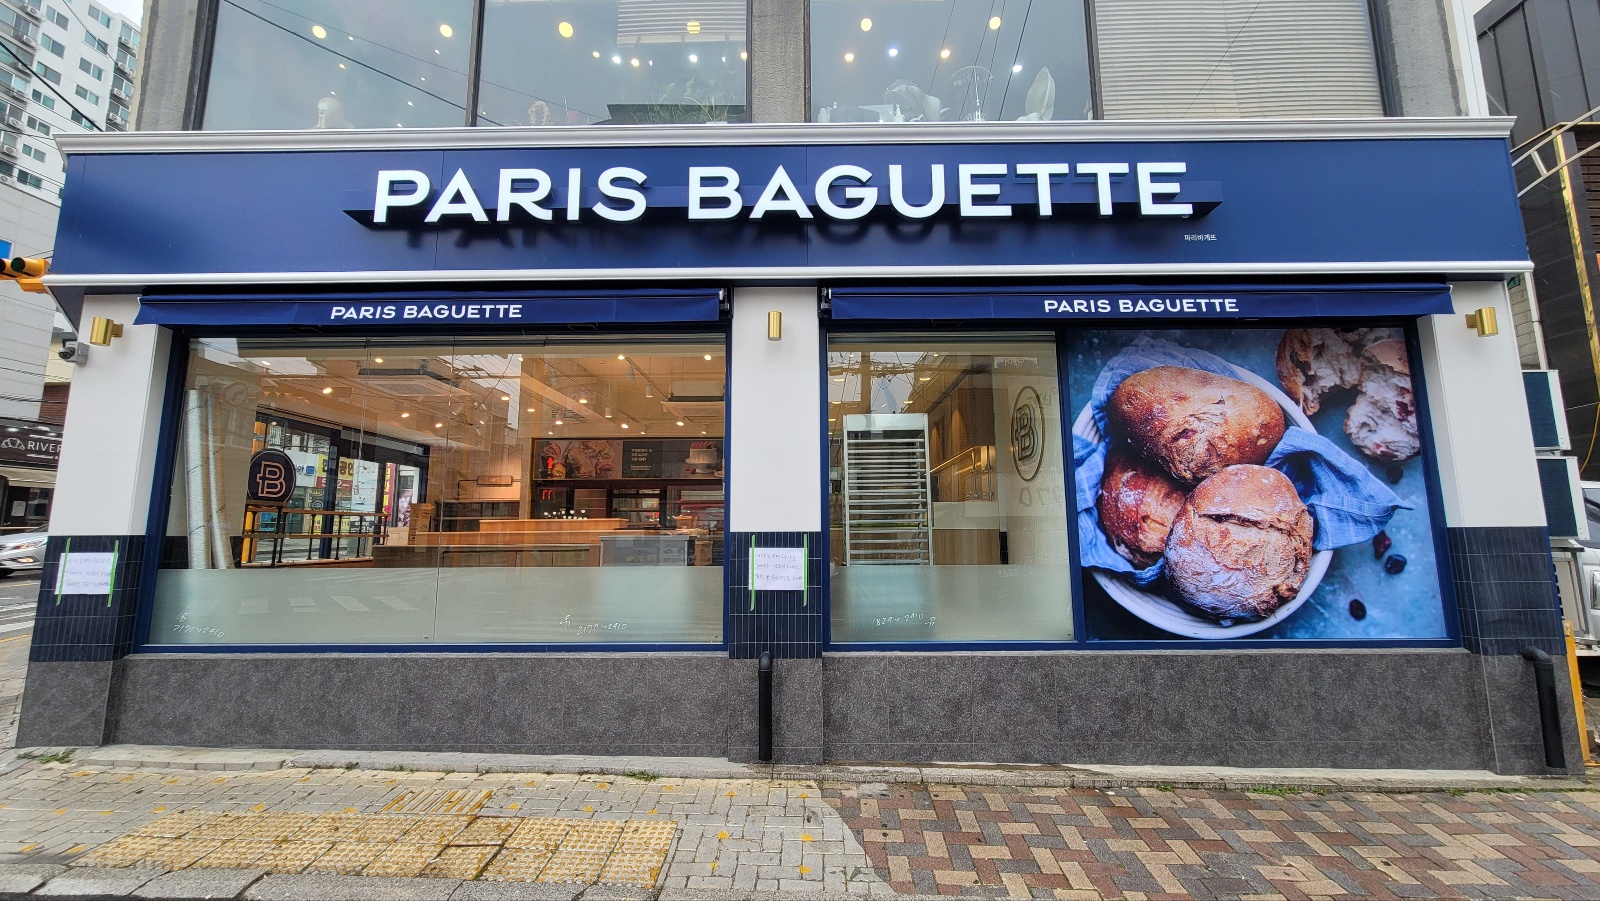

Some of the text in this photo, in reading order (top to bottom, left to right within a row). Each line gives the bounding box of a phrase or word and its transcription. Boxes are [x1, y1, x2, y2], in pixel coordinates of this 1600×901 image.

[374, 162, 1193, 222] PARIS BAGUETTE
[1183, 233, 1218, 242] 파리바게뜨
[330, 304, 523, 320] PARIS BAGUETTE
[1044, 298, 1240, 313] PARIS BAGUETTE
